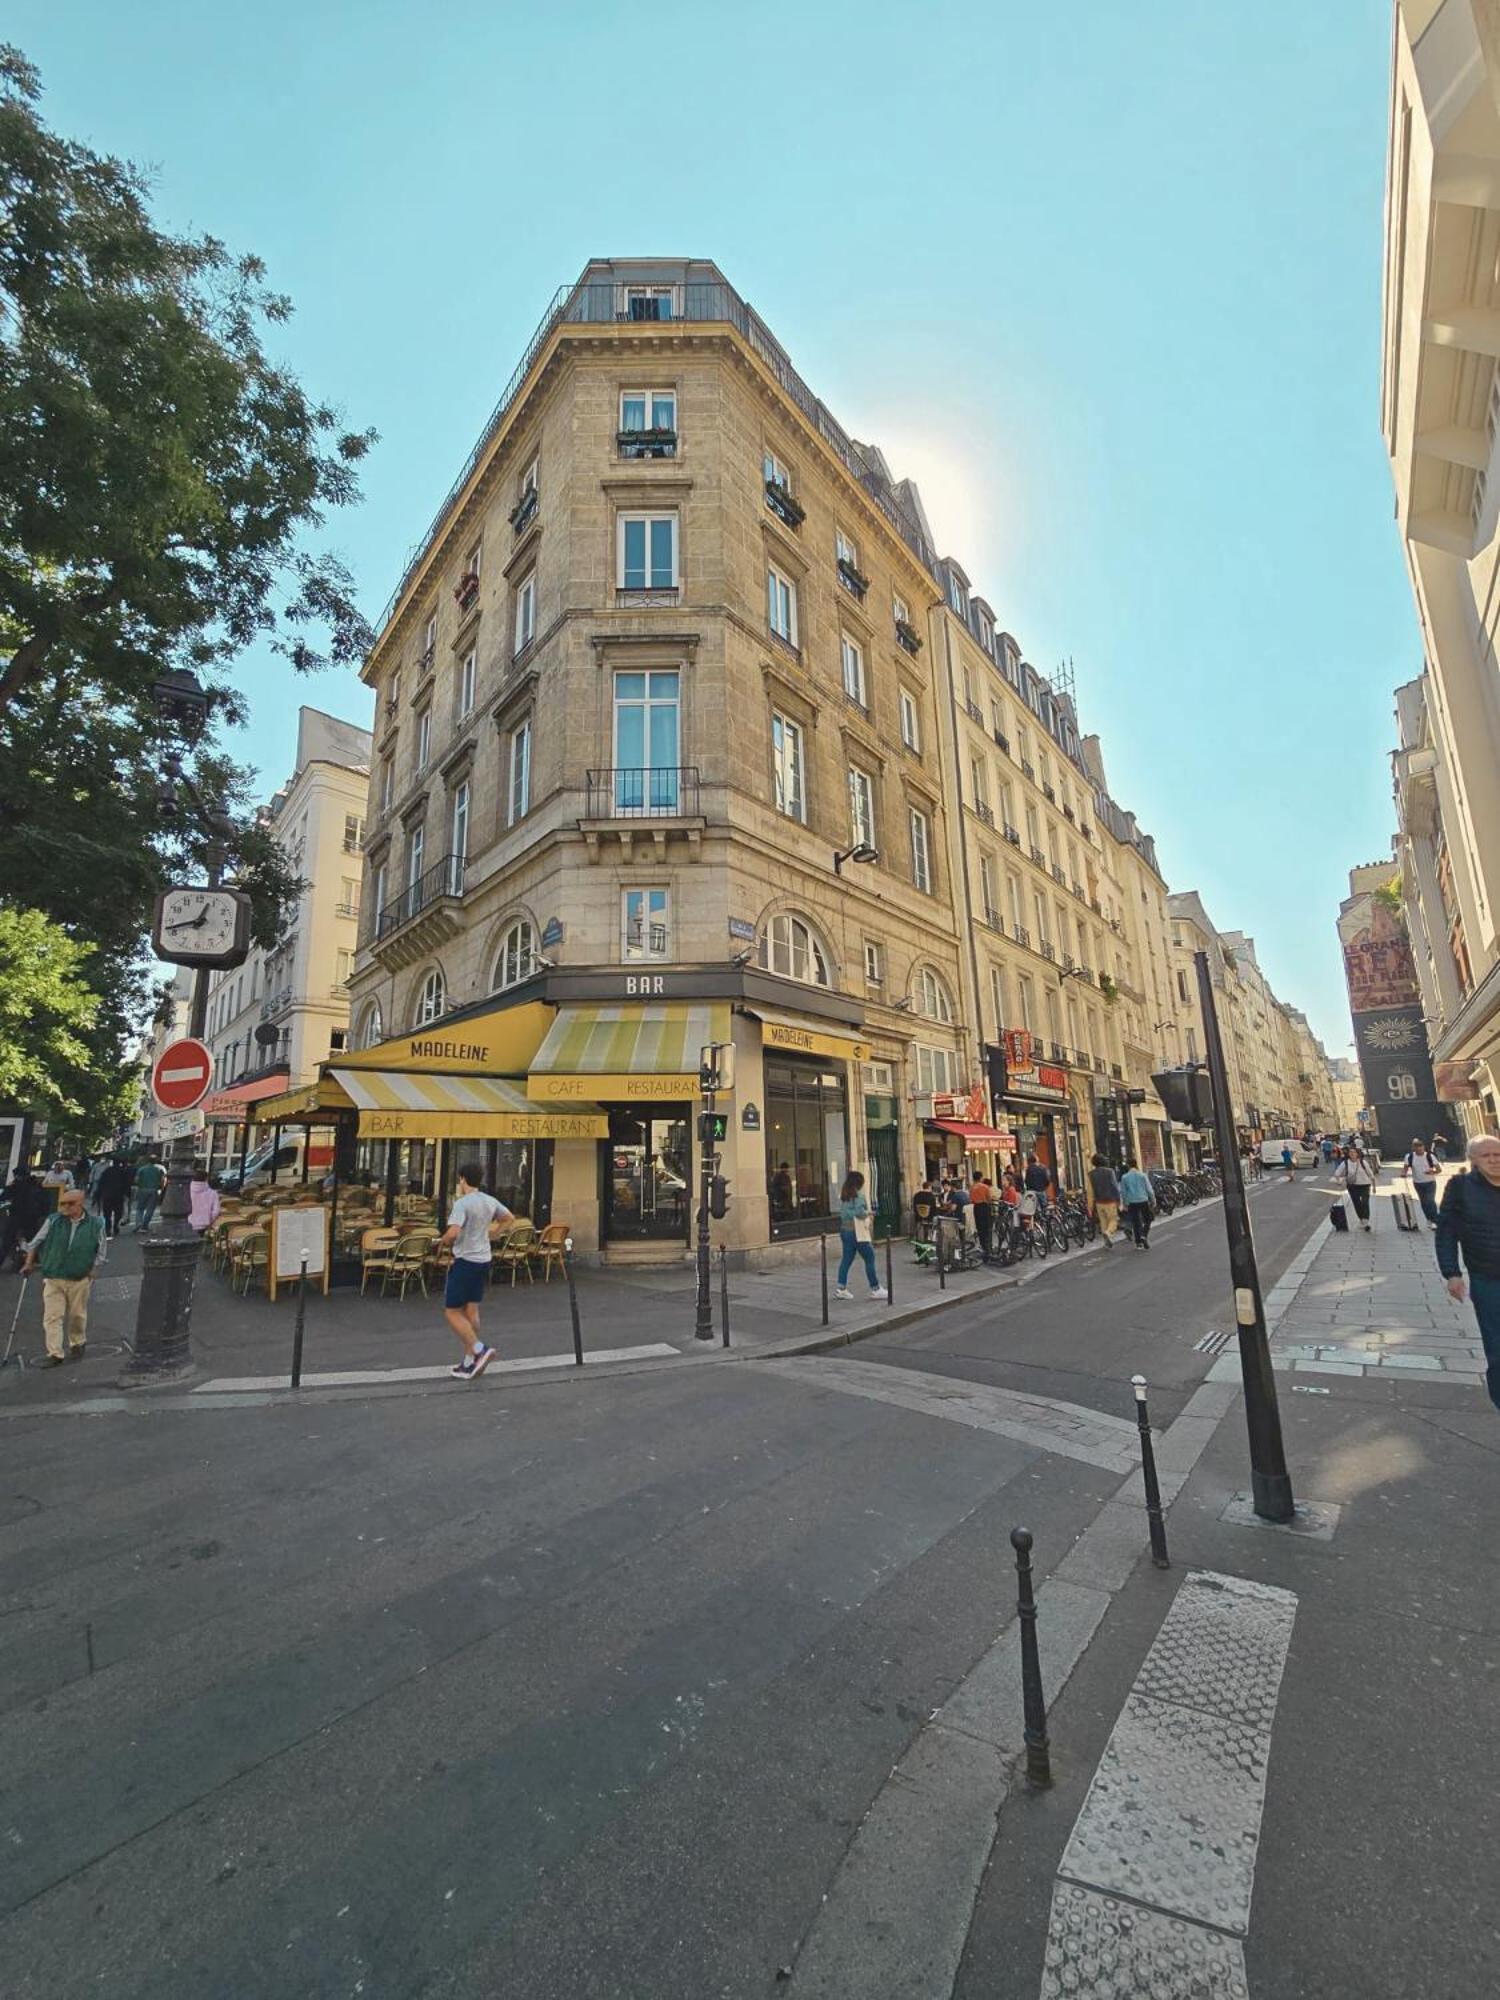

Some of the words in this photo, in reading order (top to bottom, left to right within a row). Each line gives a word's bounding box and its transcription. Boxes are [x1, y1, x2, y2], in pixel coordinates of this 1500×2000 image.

[627, 976, 664, 994] BAR
[771, 1027, 814, 1050] MADELEINE
[411, 1041, 489, 1062] MADELEINE
[547, 1080, 585, 1095] CAFE
[627, 1081, 703, 1095] RESTAURAN
[1387, 1074, 1417, 1099] 90
[371, 1116, 405, 1132] BAR
[511, 1119, 598, 1135] RESTAURANT
